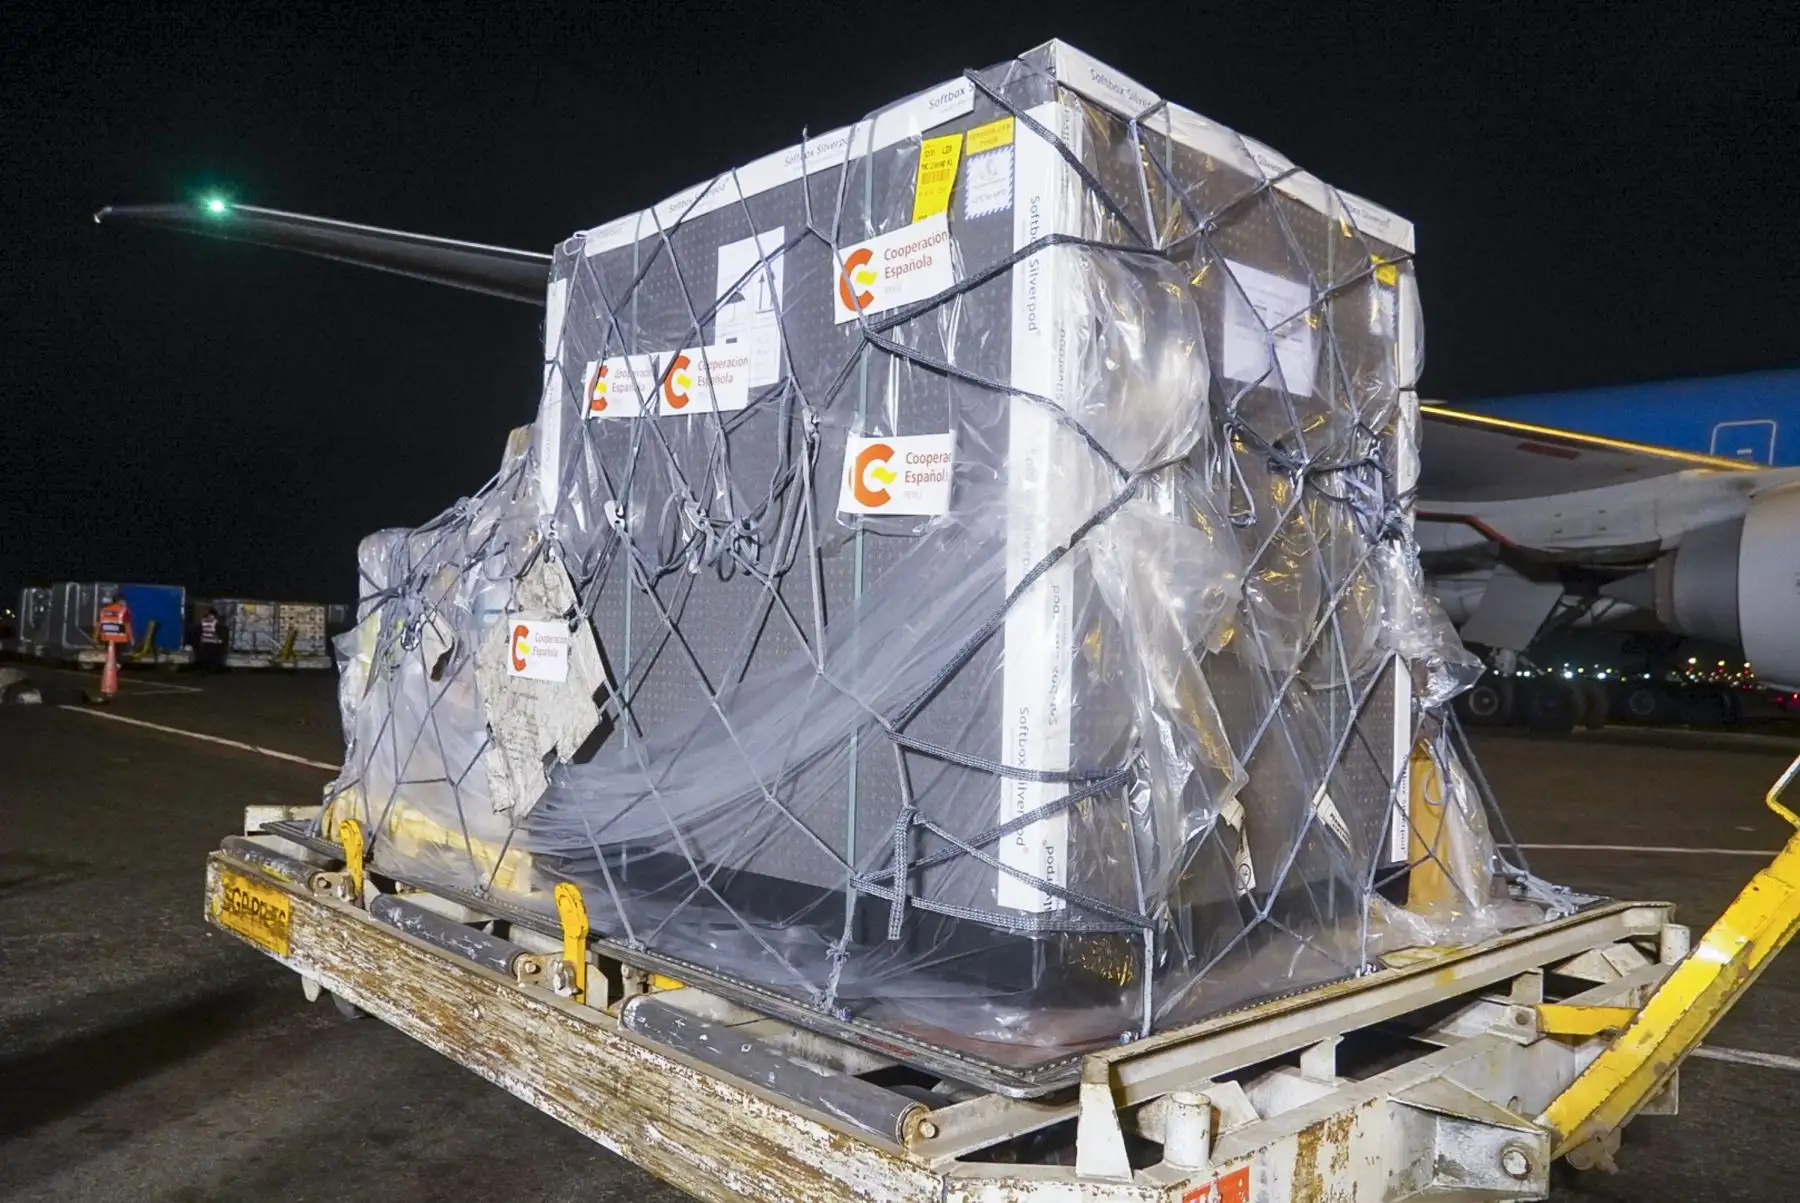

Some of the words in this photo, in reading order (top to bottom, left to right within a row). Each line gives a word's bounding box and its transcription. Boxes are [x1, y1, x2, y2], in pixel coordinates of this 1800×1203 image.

[928, 86, 966, 109] Softbox
[883, 230, 948, 261] Cooperación
[1030, 195, 1041, 246] Softbo
[884, 254, 933, 280] Española
[1028, 257, 1040, 332] Silverpod
[1016, 706, 1029, 766] Softbox
[1015, 773, 1028, 847] ilverod
